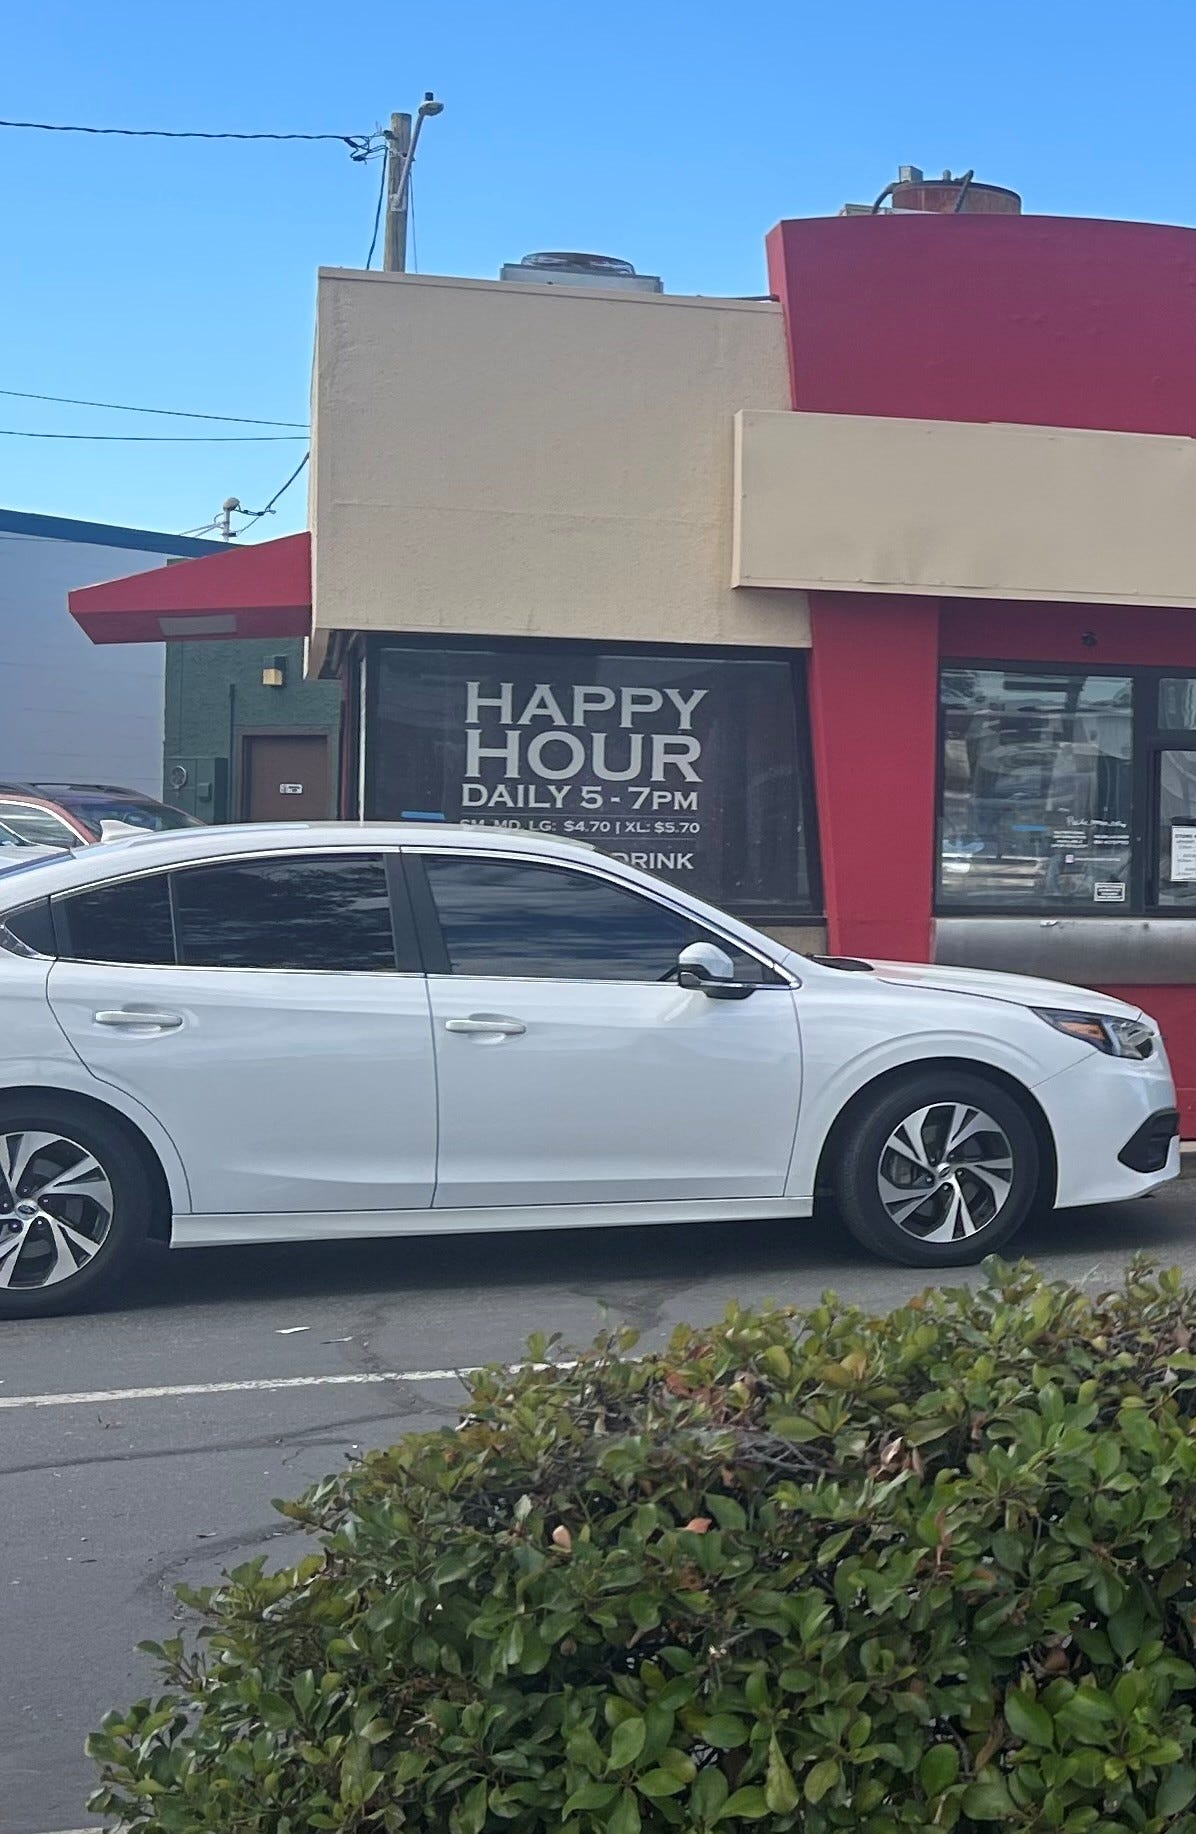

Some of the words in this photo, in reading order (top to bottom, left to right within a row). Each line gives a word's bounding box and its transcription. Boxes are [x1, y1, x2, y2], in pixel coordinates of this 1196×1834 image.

[465, 681, 709, 730] HAPPY
[464, 728, 703, 783] HOUR
[461, 783, 572, 808] DAILY
[579, 785, 603, 809] 5
[627, 786, 698, 810] 7PM
[529, 820, 556, 832] LG:
[563, 820, 611, 832] $4.70
[624, 821, 651, 833] XL:
[654, 820, 700, 834] $5.70
